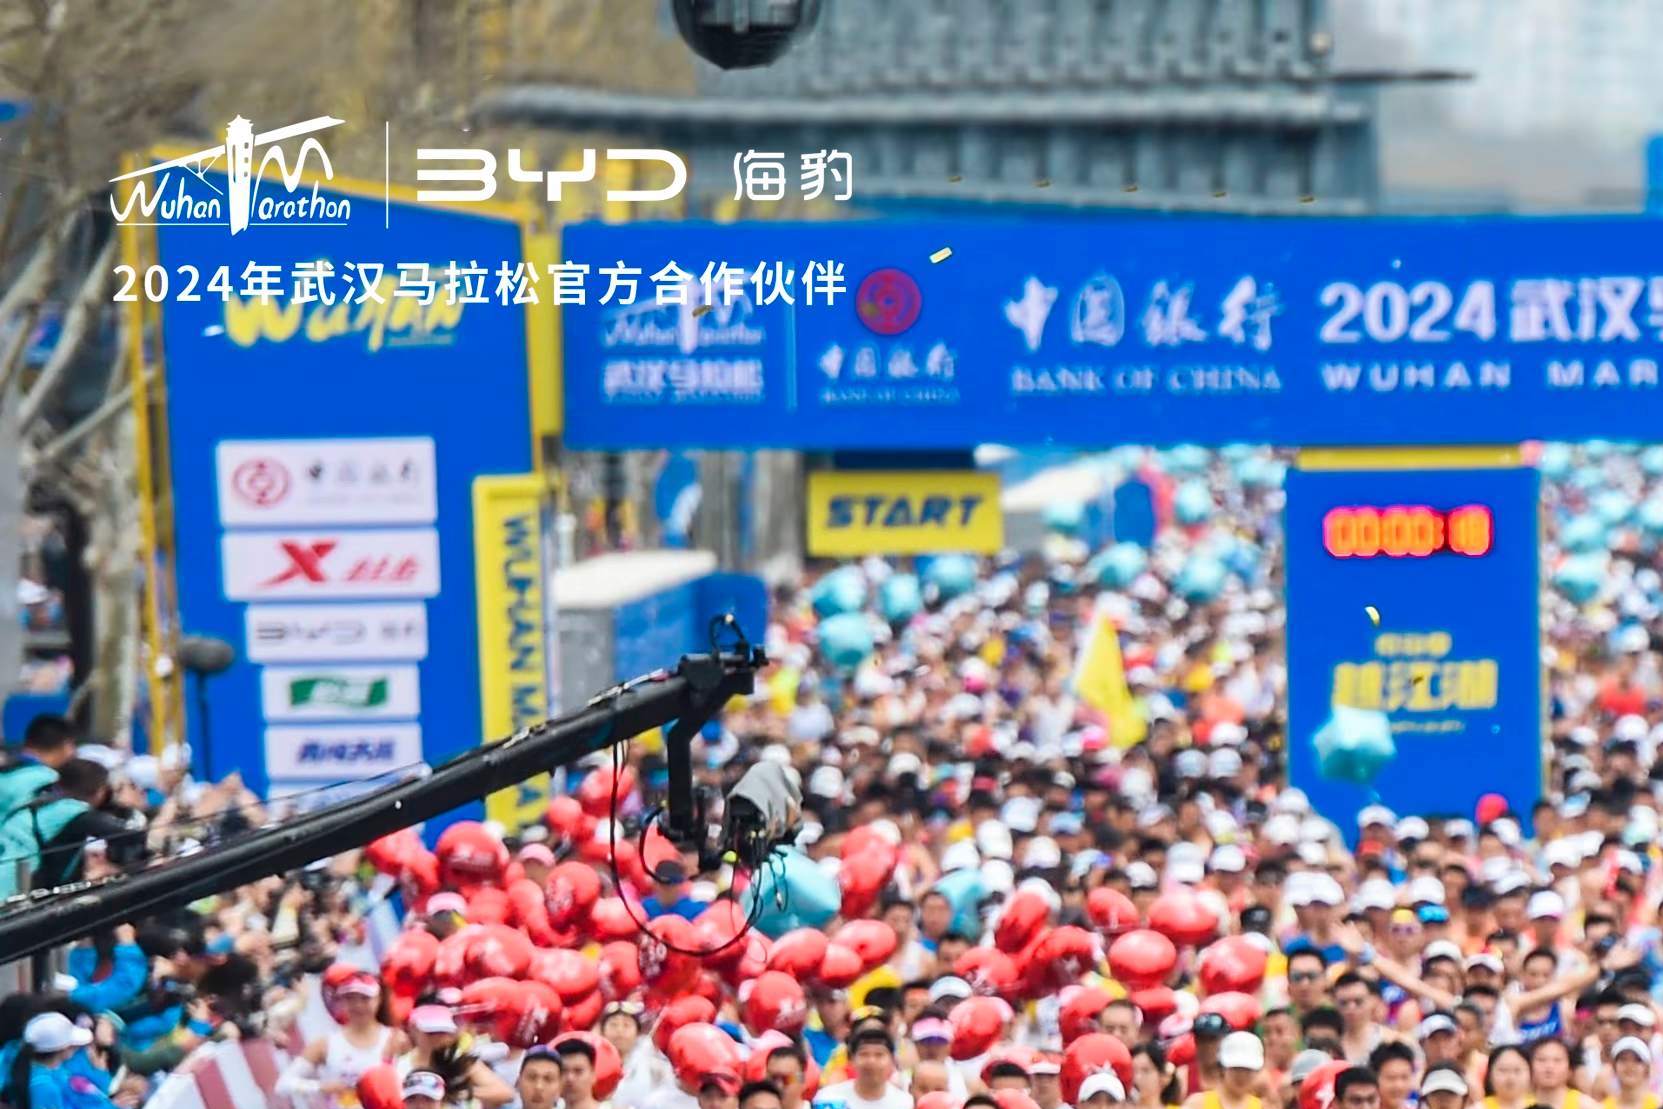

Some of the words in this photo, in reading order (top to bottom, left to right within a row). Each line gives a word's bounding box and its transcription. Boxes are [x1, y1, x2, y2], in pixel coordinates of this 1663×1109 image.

[1320, 280, 1496, 342] 2024
[1012, 366, 1104, 392] BANK
[1112, 366, 1154, 392] OF
[1170, 365, 1282, 392] CHINA
[1321, 360, 1511, 390] WUHAN
[825, 493, 985, 528] START
[502, 512, 537, 673] WUHAN
